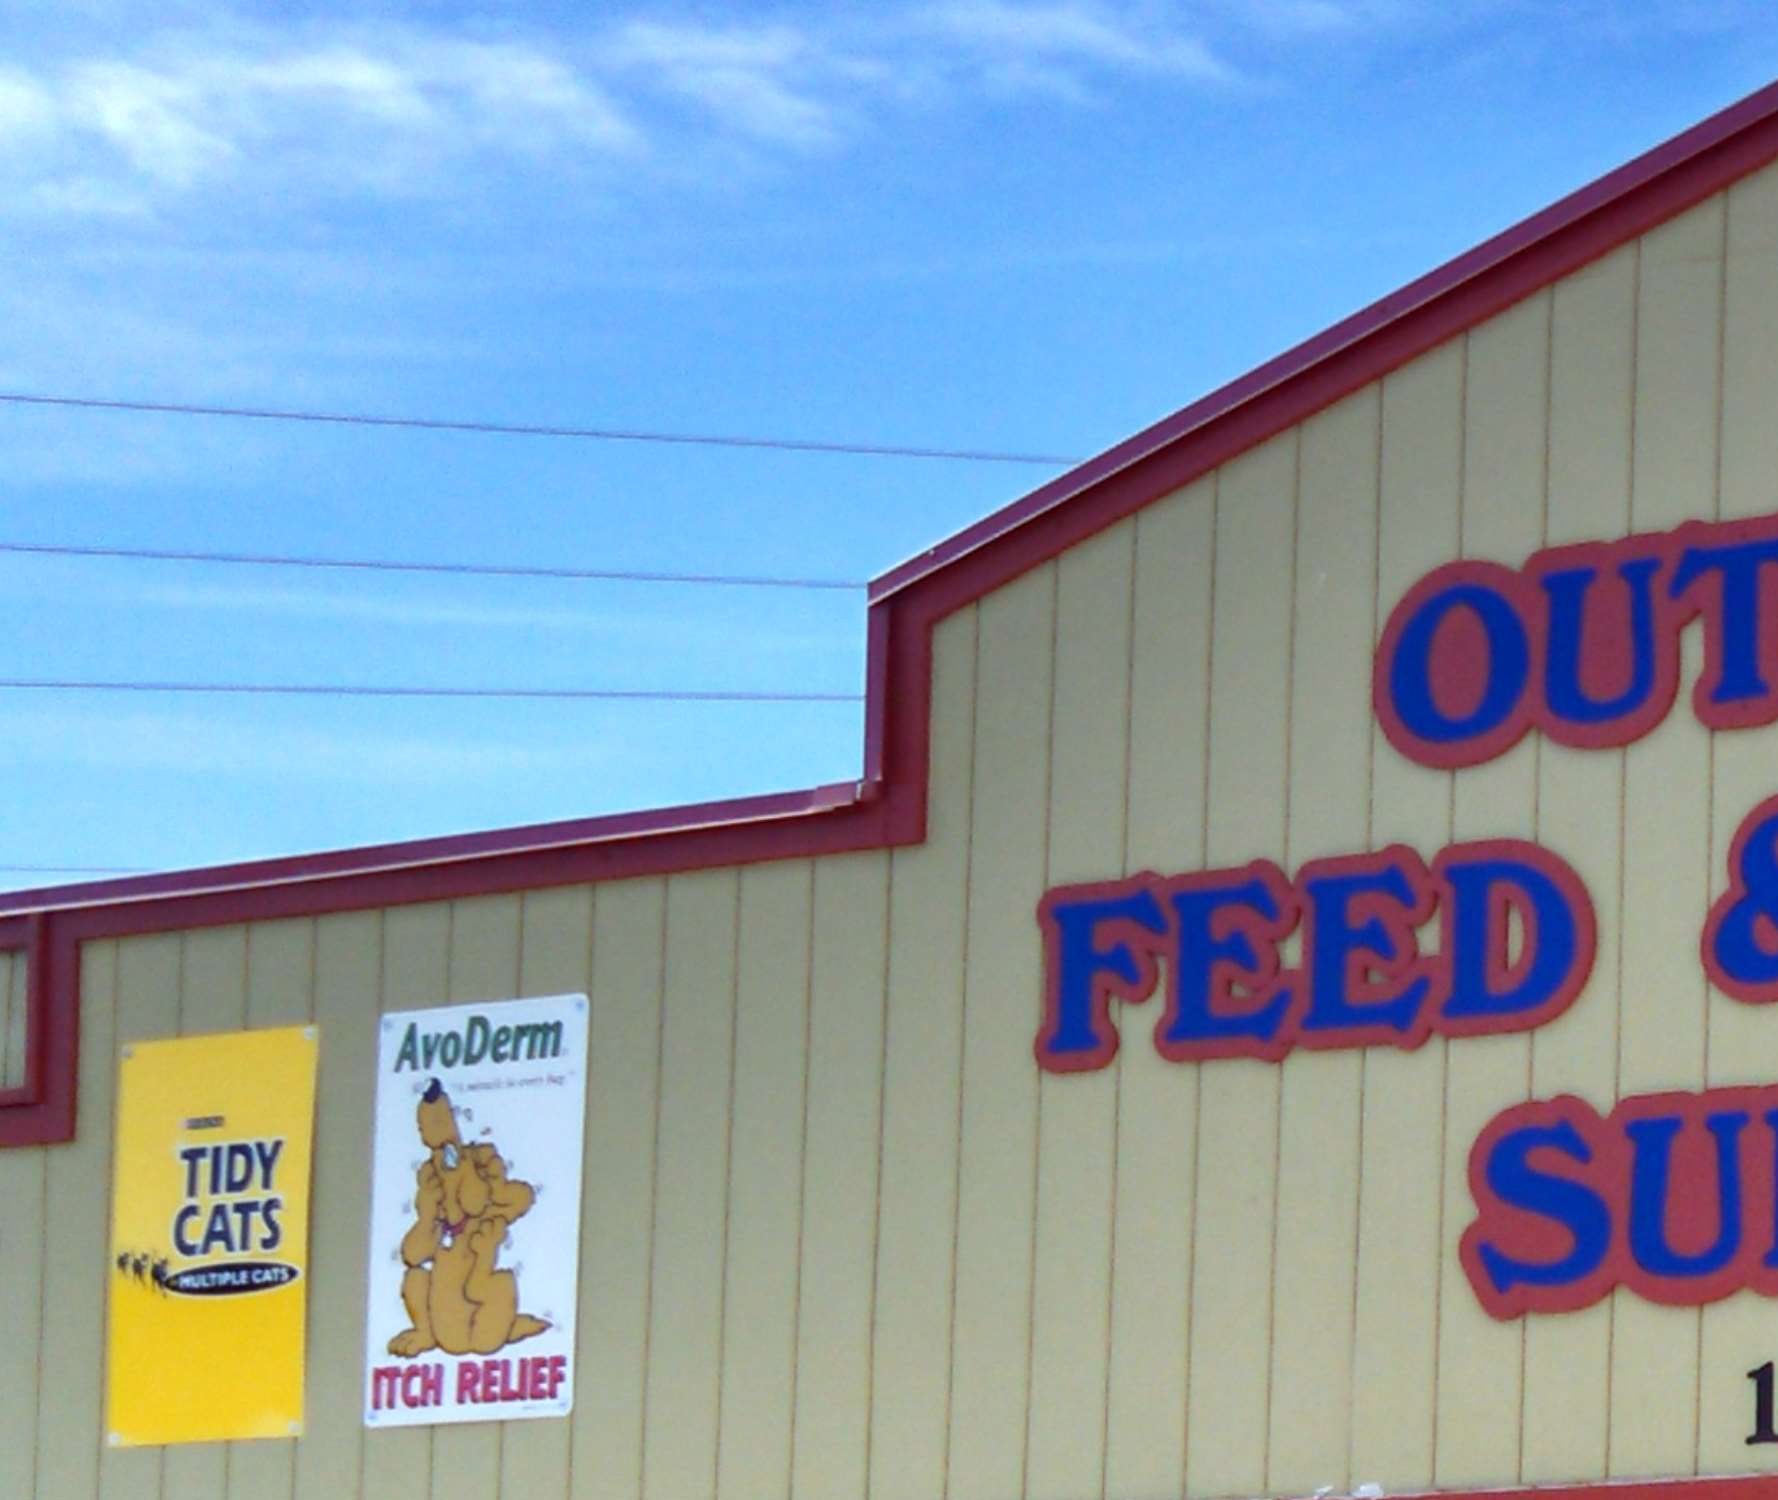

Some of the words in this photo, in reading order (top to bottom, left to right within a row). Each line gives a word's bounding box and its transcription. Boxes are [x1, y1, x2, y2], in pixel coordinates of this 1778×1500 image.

[1048, 860, 1577, 1053] FEED
[393, 1015, 564, 1073] AvoDerm
[180, 1139, 284, 1199] TIDY
[173, 1197, 283, 1257] CATS
[179, 1270, 249, 1289] MULTIPLE
[251, 1267, 290, 1284] CATS
[371, 1362, 446, 1411] ITCH
[455, 1354, 568, 1405] RELIEF
